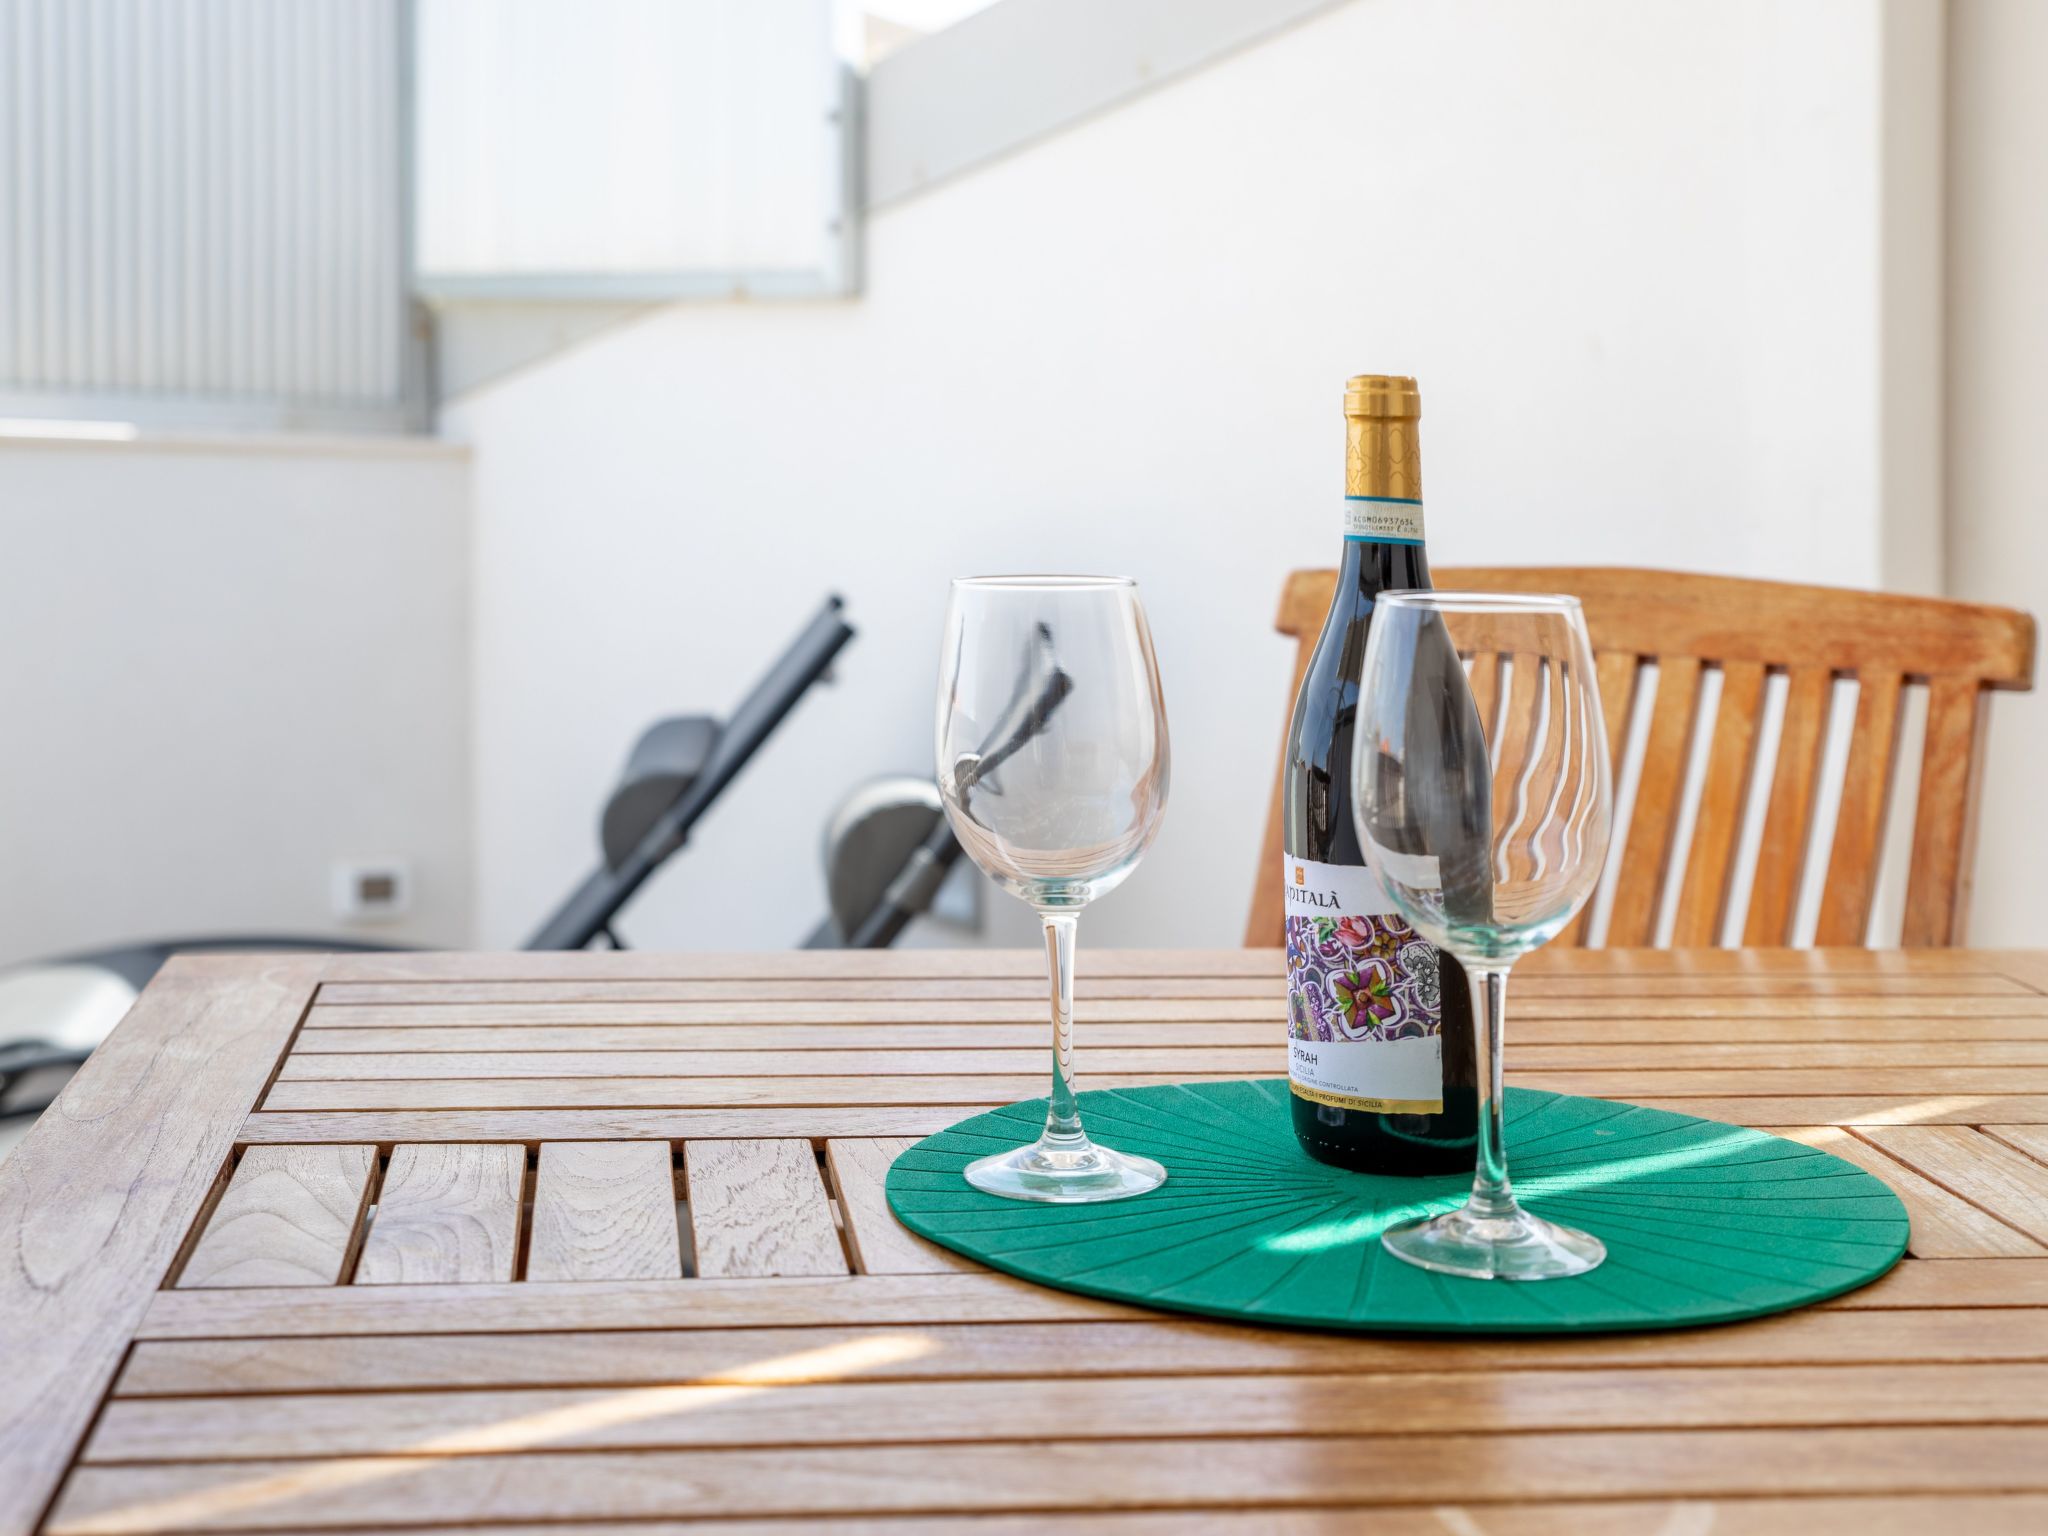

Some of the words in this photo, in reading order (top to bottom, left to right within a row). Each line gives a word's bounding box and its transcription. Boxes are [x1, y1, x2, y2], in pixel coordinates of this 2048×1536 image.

[1293, 1047, 1318, 1066] SYRAH
[1319, 1080, 1359, 1092] CONTROLLATA
[1319, 1093, 1347, 1104] PROFUMI
[1348, 1098, 1356, 1106] DI
[1357, 1099, 1383, 1108] SICILIA
